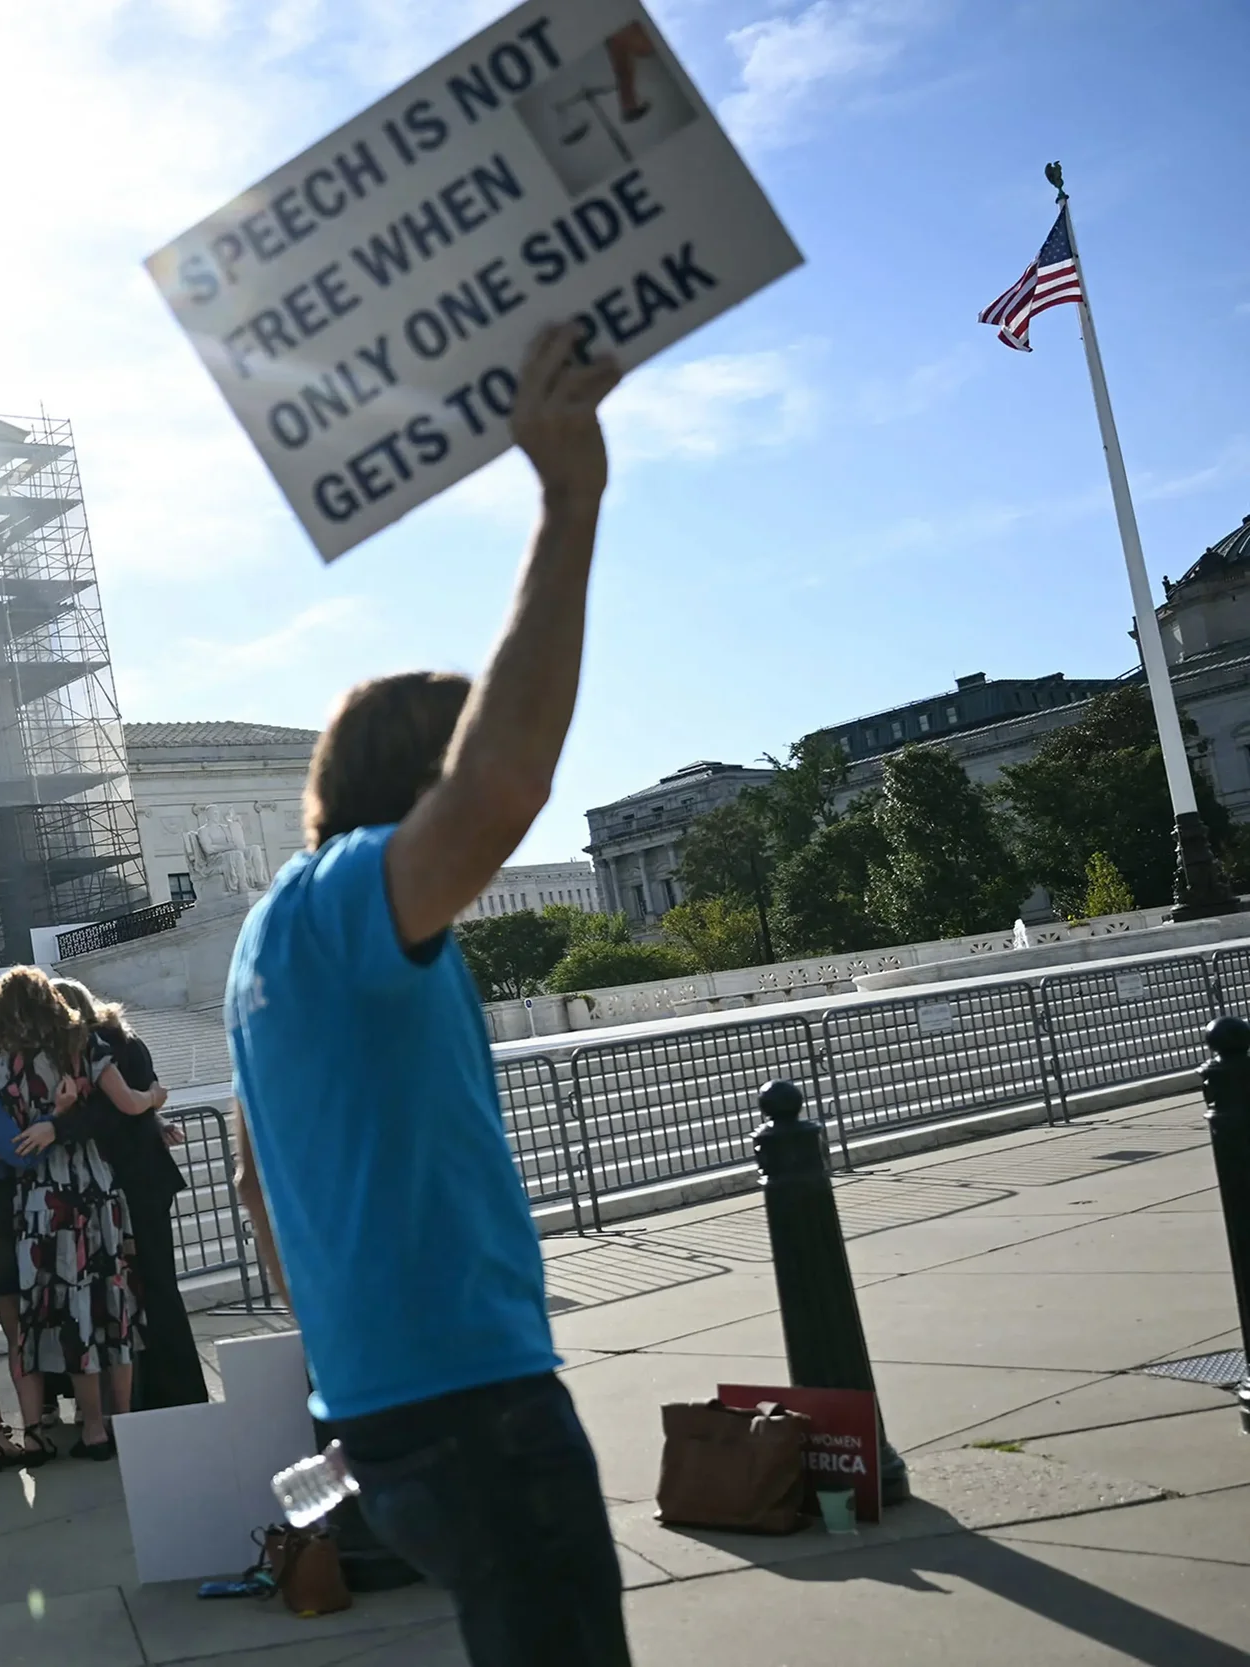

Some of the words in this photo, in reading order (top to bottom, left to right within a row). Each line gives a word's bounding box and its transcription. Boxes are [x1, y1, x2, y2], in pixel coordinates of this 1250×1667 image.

[178, 141, 387, 304] SPEECH
[383, 101, 450, 167] IS
[446, 15, 561, 124] NOT
[222, 263, 362, 381] FREE
[349, 152, 524, 289] WHEN
[267, 335, 400, 451] ONLY
[403, 258, 527, 361] ONE
[521, 168, 665, 286] SIDE
[312, 414, 450, 524] GETS
[443, 366, 518, 438] TO
[570, 242, 718, 366] PEAK
[801, 1451, 867, 1475] ERICA
[810, 1433, 862, 1449] WOMEN
